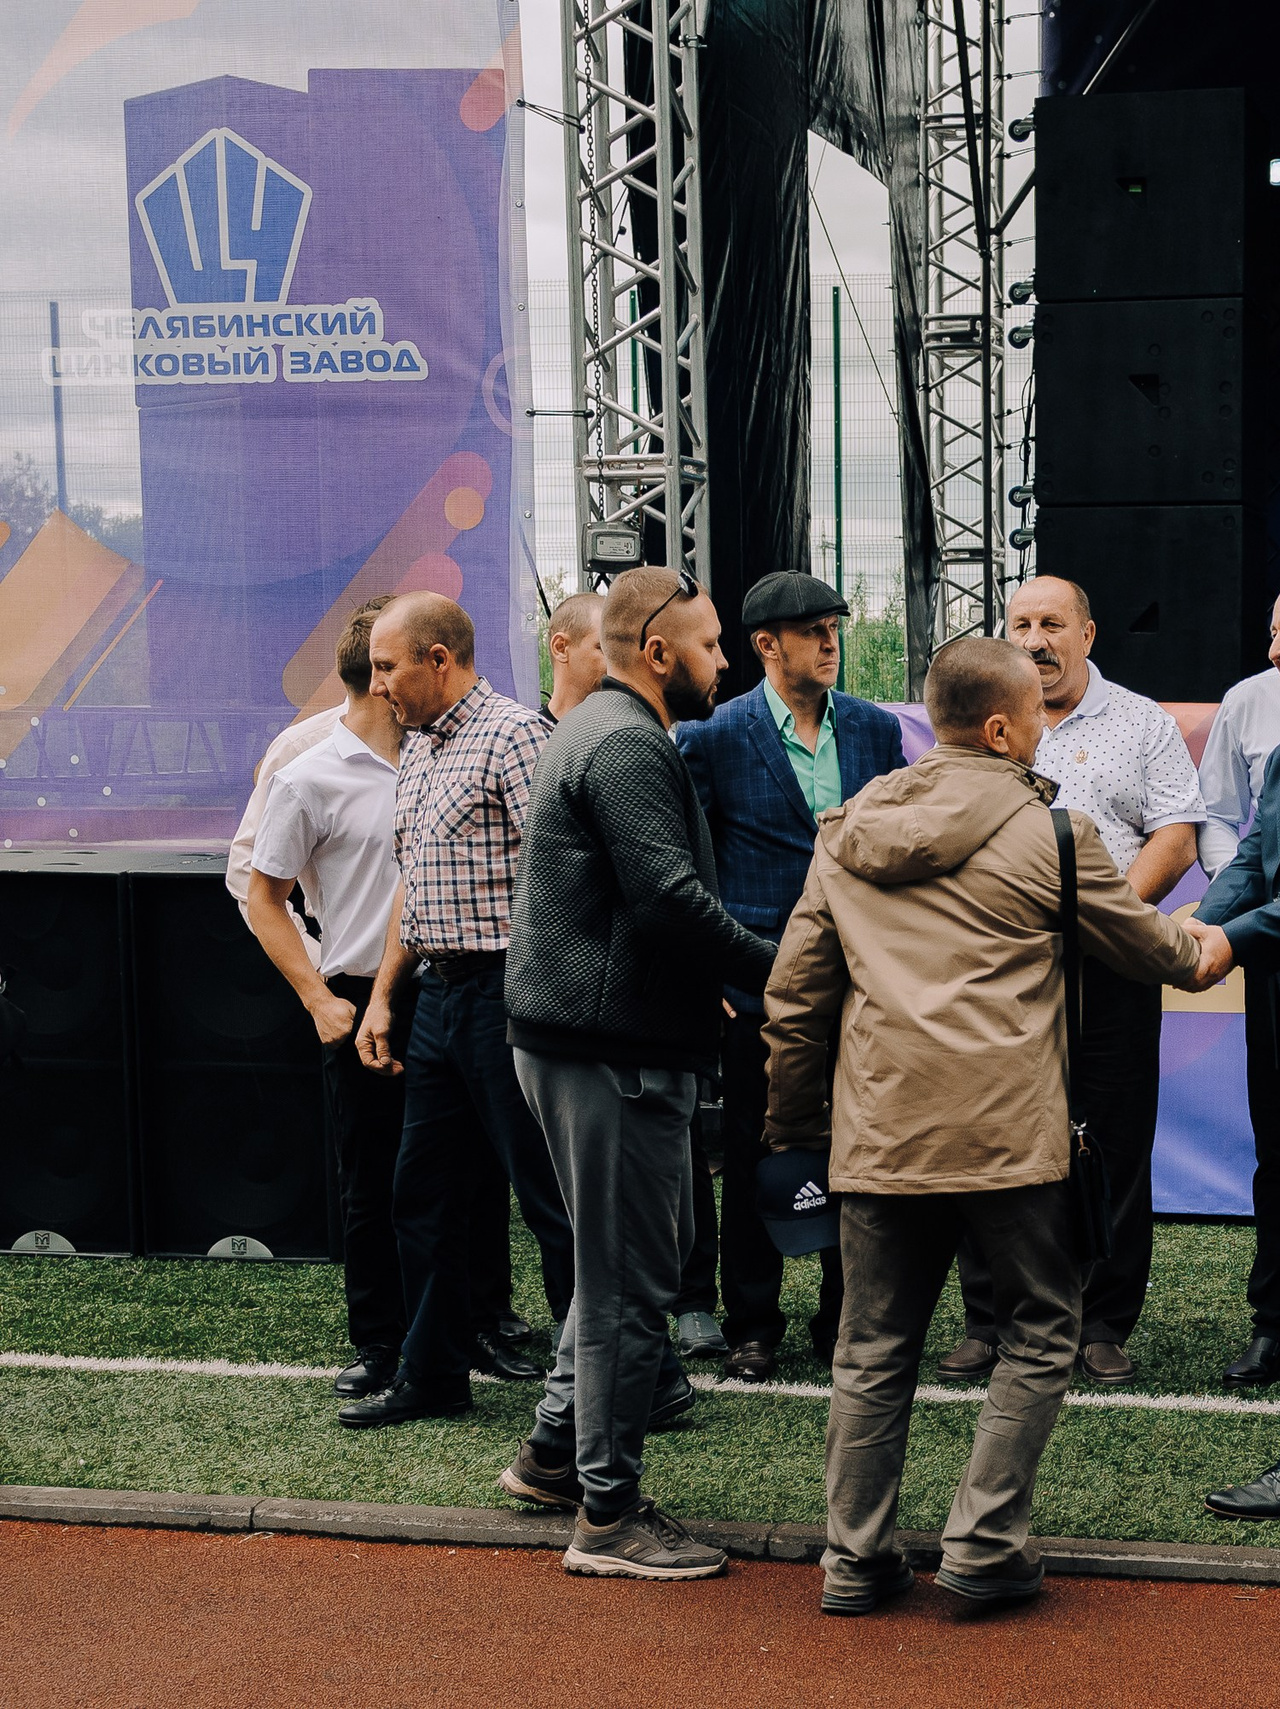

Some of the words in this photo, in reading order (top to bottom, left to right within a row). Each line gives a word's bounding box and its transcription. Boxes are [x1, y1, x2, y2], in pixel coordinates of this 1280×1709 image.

[87, 306, 376, 340] ЧЕЛЯБИНСКИЙ
[50, 346, 270, 377] ЦИНКОВЫЙ
[290, 349, 421, 375] ЗАВОД
[793, 1196, 827, 1211] adidas
